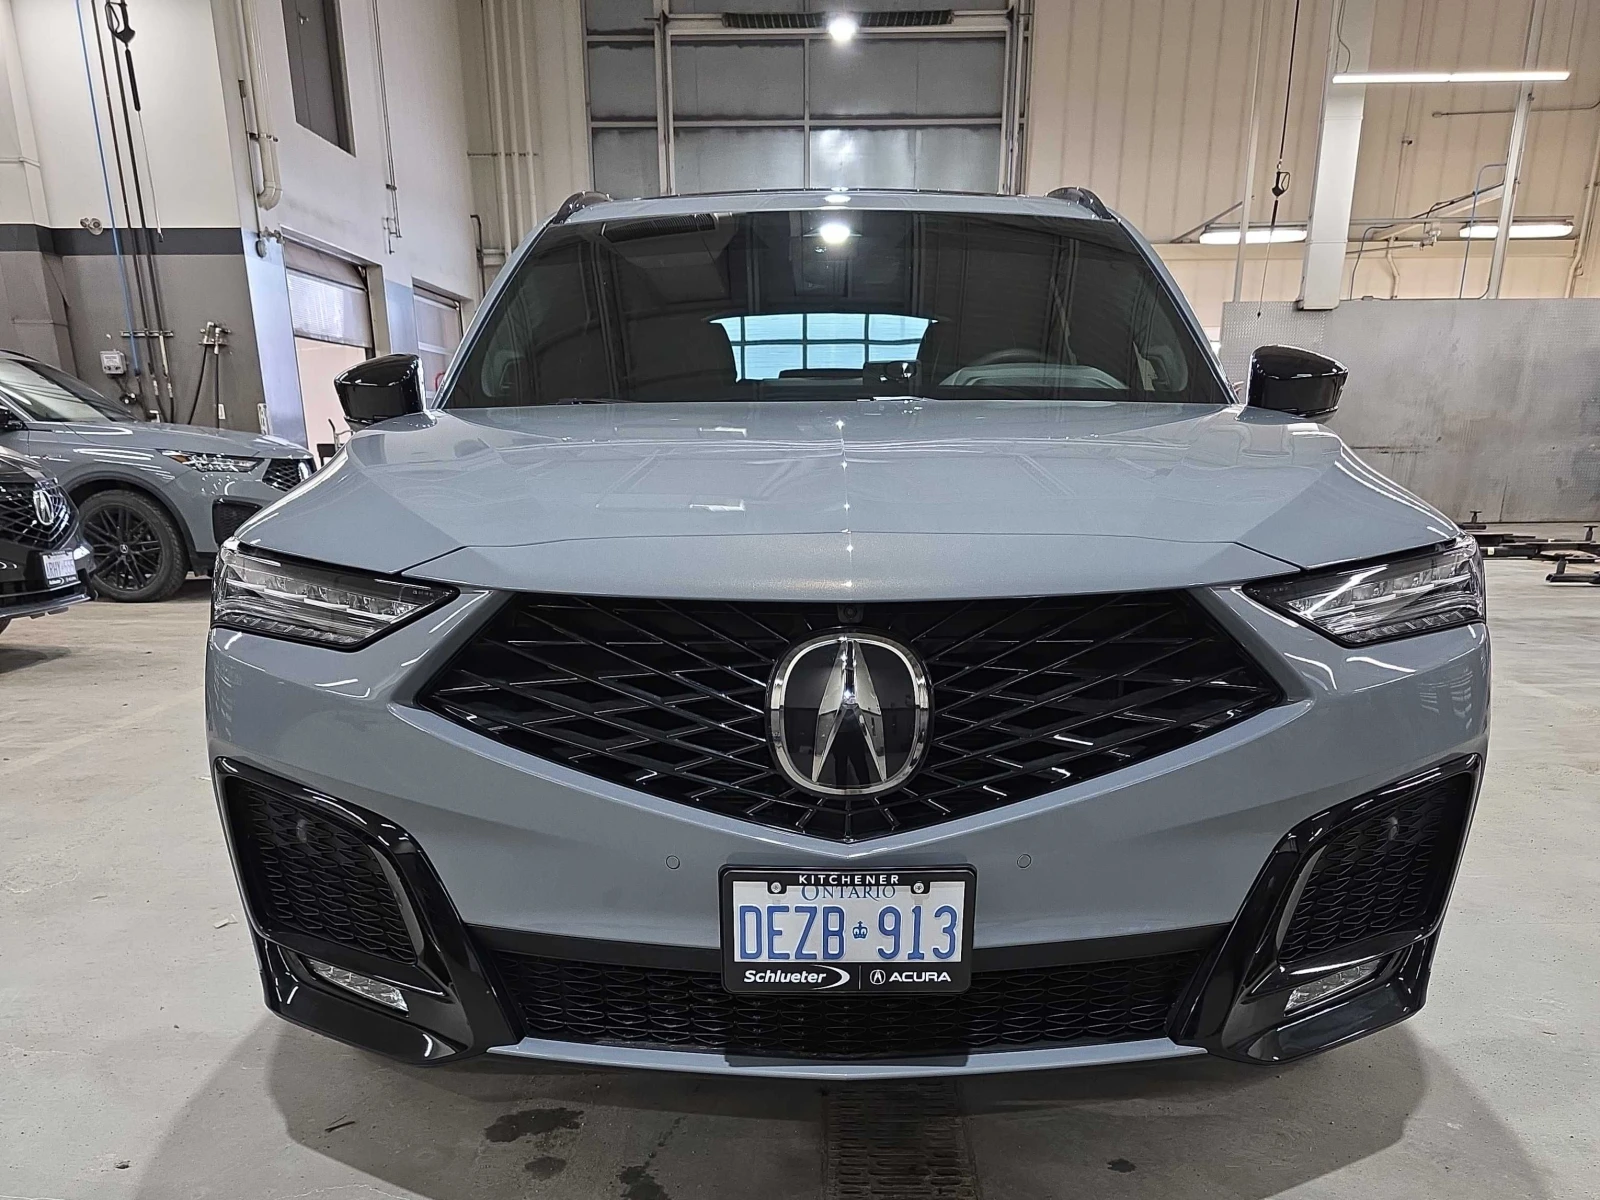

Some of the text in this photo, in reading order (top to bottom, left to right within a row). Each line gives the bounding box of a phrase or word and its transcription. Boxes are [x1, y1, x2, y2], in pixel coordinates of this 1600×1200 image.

[799, 874, 899, 885] KITCHENER
[801, 885, 896, 902] ONTARIO
[739, 905, 958, 960] DEZB 913
[743, 969, 826, 984] Schlueter
[889, 971, 951, 982] ACURA
